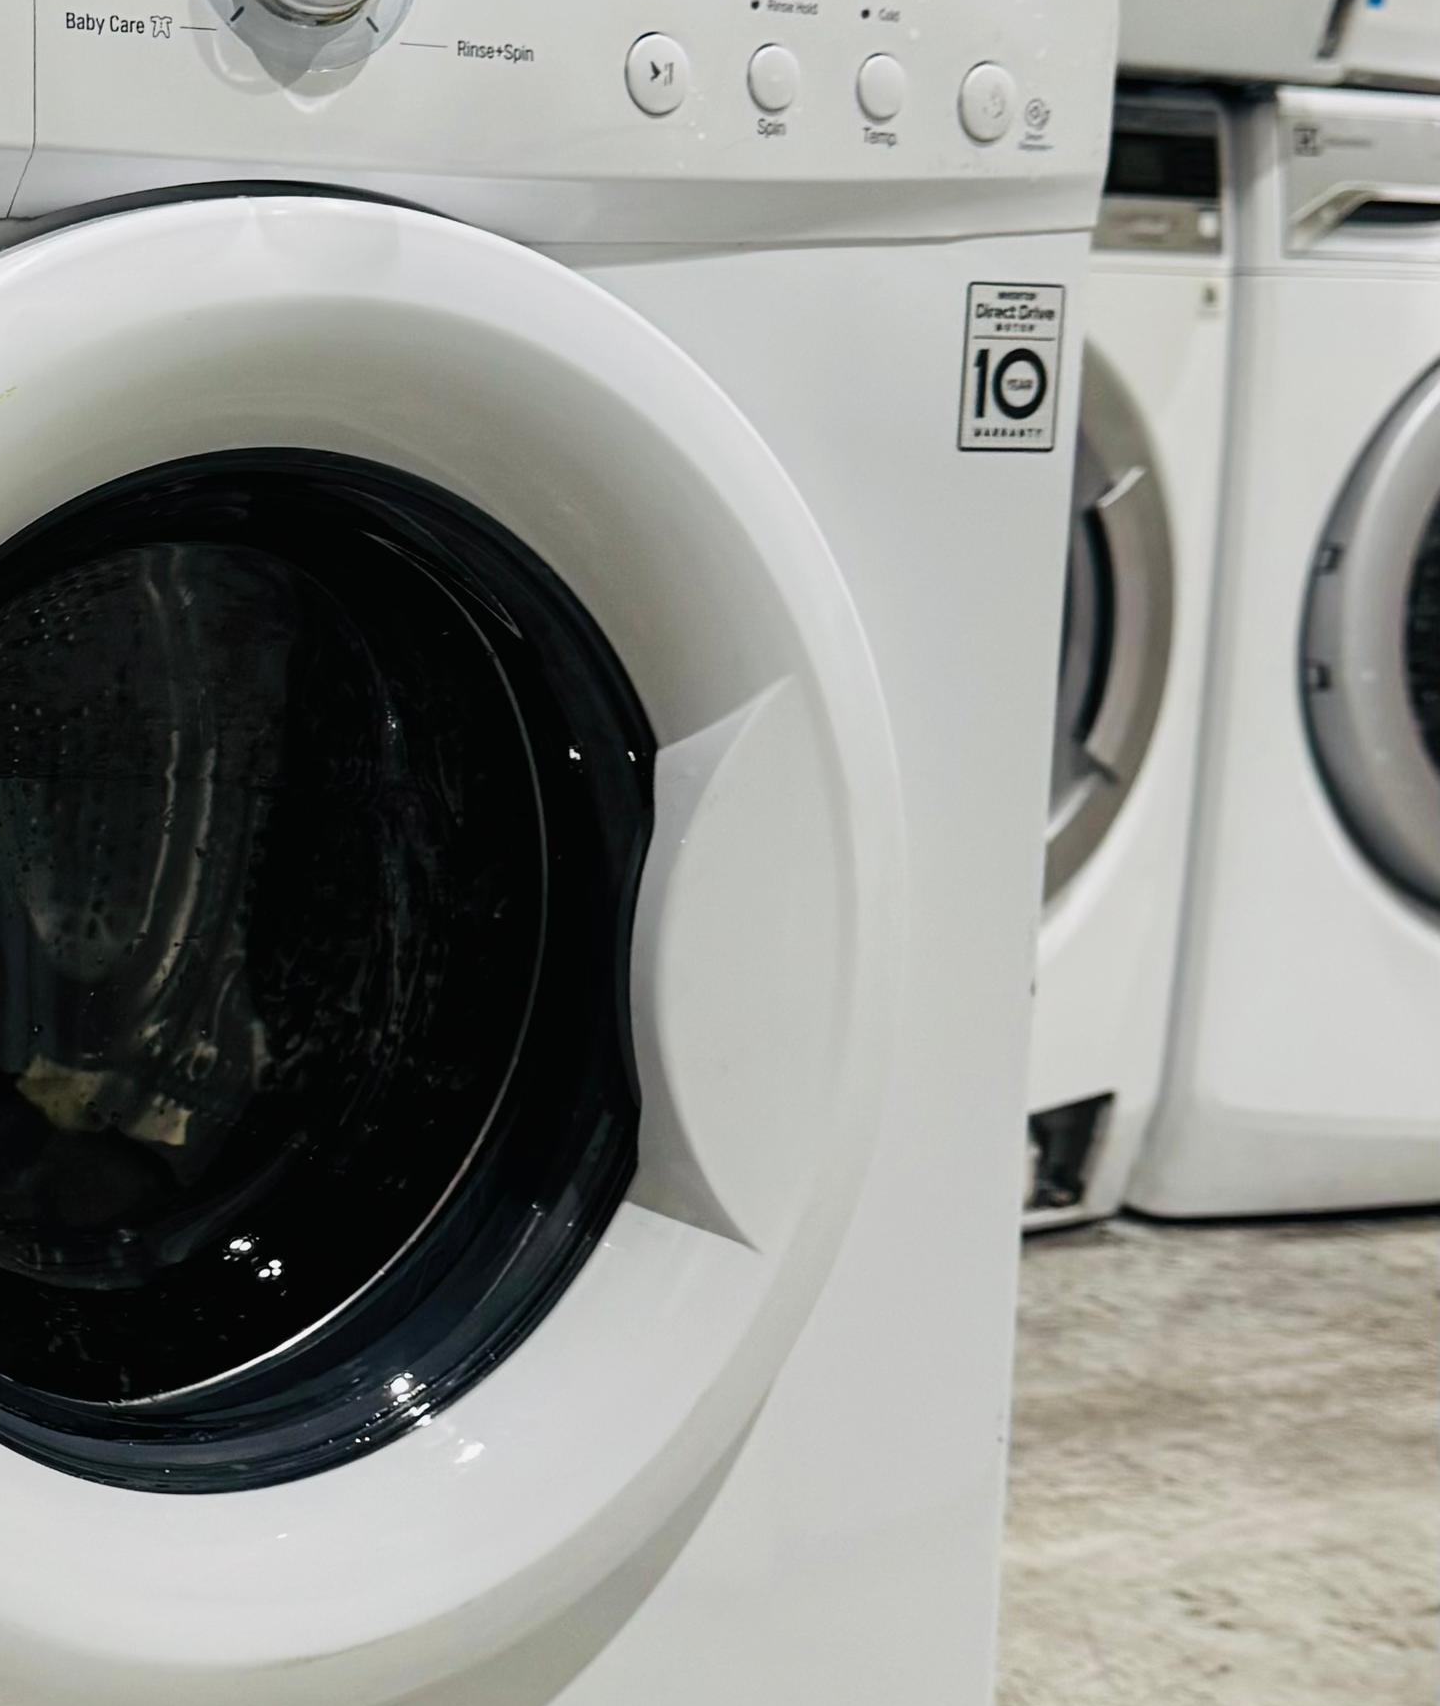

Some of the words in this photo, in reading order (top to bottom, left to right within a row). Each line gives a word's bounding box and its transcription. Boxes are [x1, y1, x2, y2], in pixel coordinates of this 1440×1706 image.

[66, 12, 105, 35] Baby
[110, 15, 144, 34] Care
[457, 40, 534, 64] Rinse+Spin
[757, 118, 786, 138] Spin
[976, 304, 1015, 320] Direct
[1019, 305, 1055, 321] Drive
[974, 348, 1047, 420] 10
